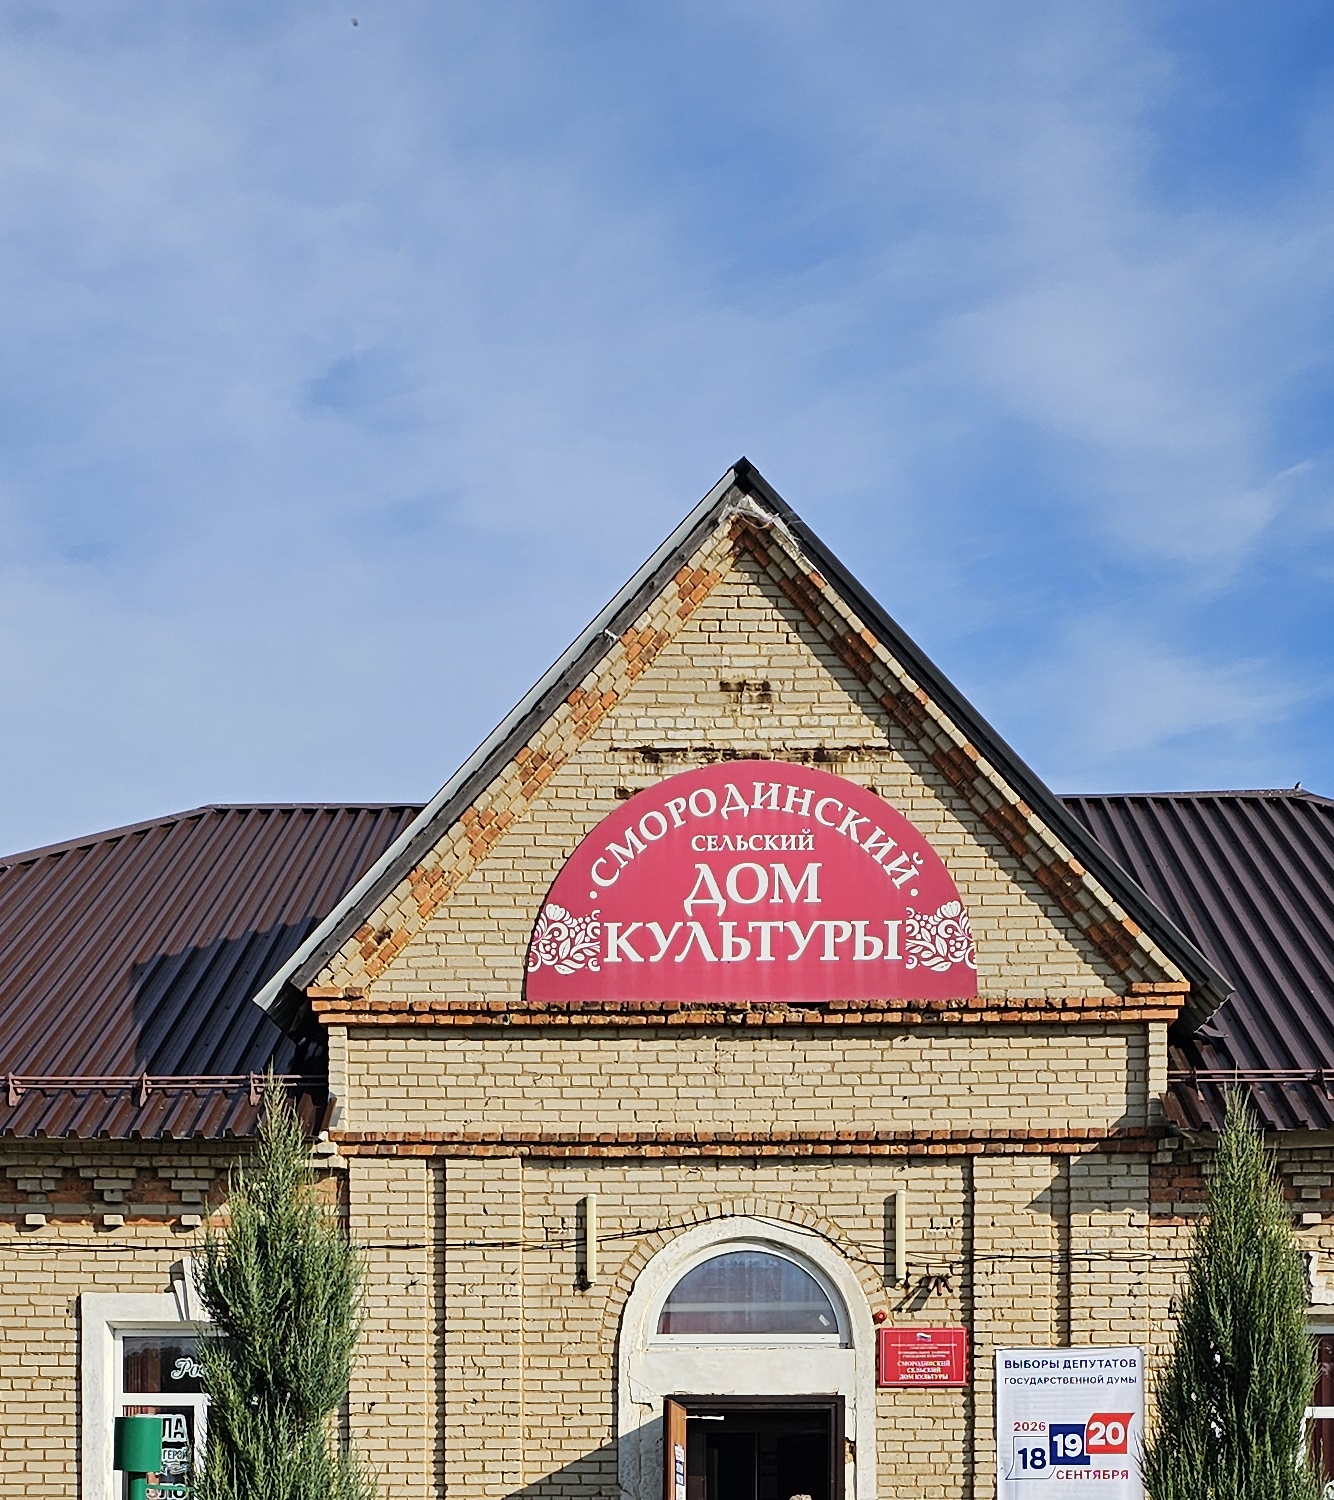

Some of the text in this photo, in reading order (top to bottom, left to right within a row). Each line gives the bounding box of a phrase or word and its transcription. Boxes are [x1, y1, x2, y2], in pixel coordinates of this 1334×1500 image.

[591, 782, 924, 888] СМОРОДИНСКИЙ
[692, 829, 815, 852] СЕЛЬСКИЙ
[684, 863, 822, 917] ДОМ
[604, 921, 903, 962] КУЛЬТУРЫ
[1004, 1359, 1137, 1369] ВЫБОРЫ ДЕПУТАТОВ
[1004, 1375, 1137, 1385] ГОСУДАРСТВЕННОЙ ДУМЫ
[161, 1417, 185, 1438] ЛА
[1013, 1422, 1046, 1431] 2026
[1018, 1421, 1126, 1470] 18 19 20
[1056, 1470, 1129, 1480] СЕНТЯБРЯ
